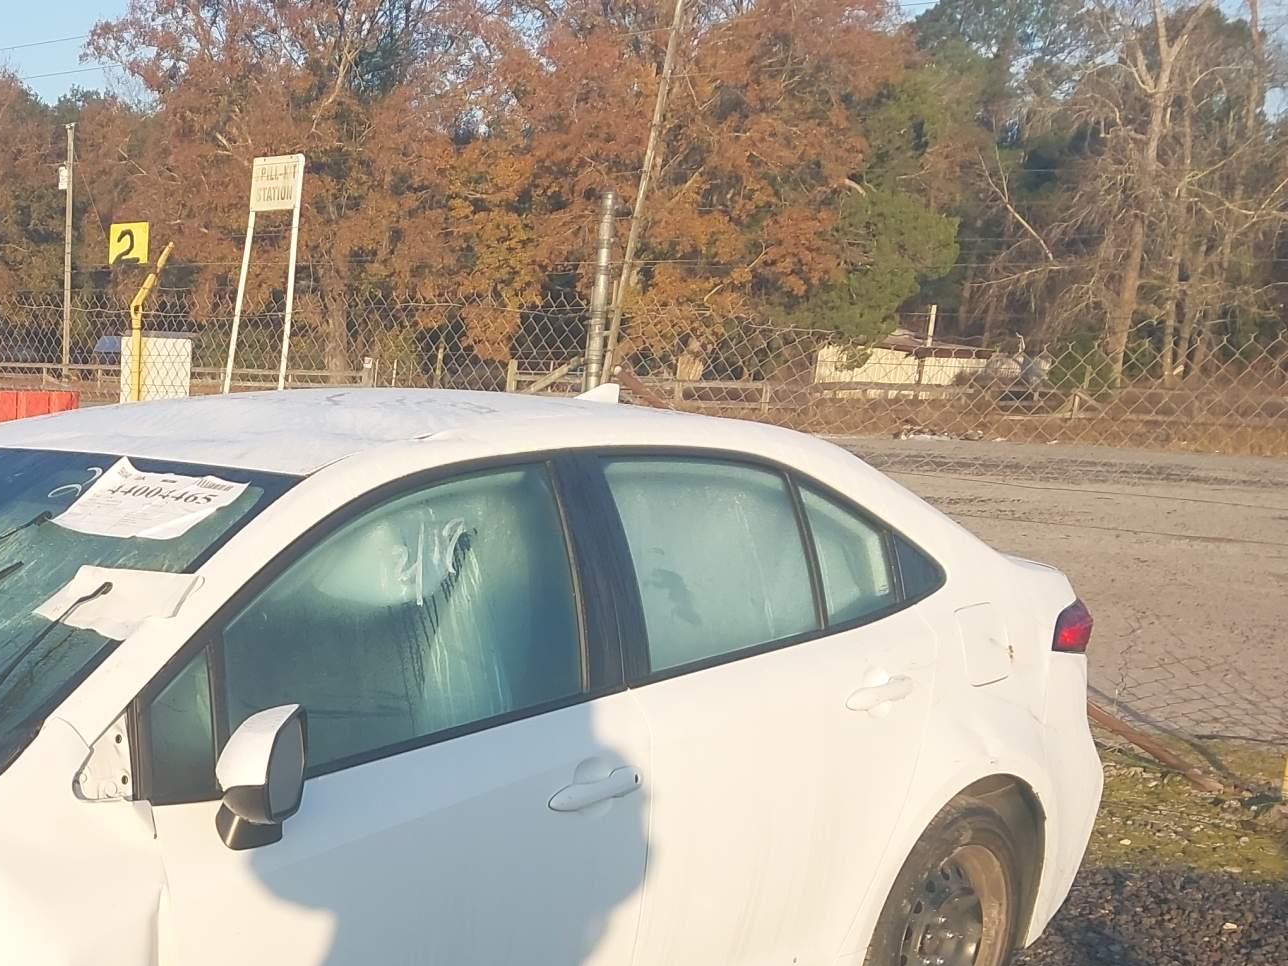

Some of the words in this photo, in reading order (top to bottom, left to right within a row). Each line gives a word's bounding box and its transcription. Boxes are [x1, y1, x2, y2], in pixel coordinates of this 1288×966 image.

[255, 185, 293, 202] STATION
[112, 229, 140, 264] 2
[108, 484, 218, 505] 44004465
